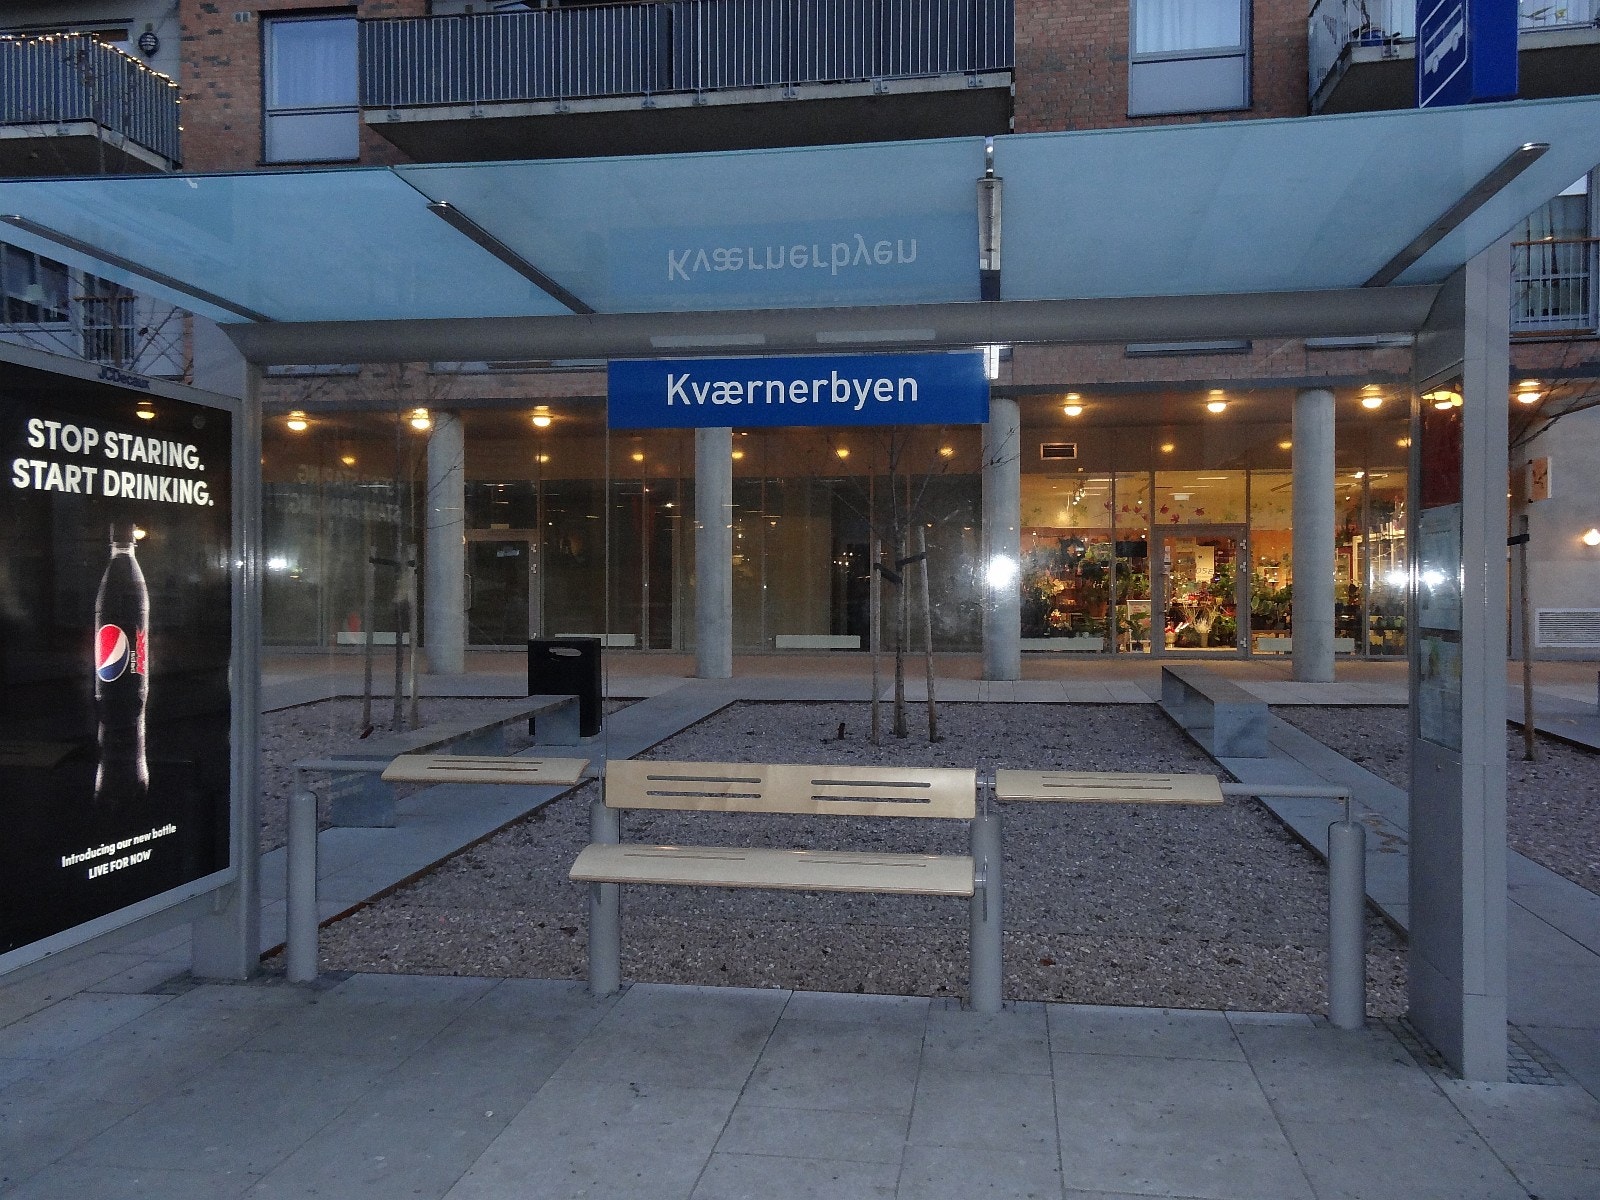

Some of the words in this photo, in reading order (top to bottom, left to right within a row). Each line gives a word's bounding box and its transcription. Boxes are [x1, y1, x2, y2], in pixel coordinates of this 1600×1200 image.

[667, 371, 918, 411] Kværnerbyen
[28, 418, 99, 455] STOP
[104, 431, 205, 471] STARING.
[12, 458, 98, 495] START
[103, 469, 214, 507] DRINKING.
[61, 843, 116, 867] Introducing
[116, 838, 133, 850] our
[133, 832, 151, 844] new
[152, 823, 177, 839] bottle
[88, 862, 109, 879] LIVE
[110, 856, 129, 872] FOR
[130, 849, 152, 865] NOW
